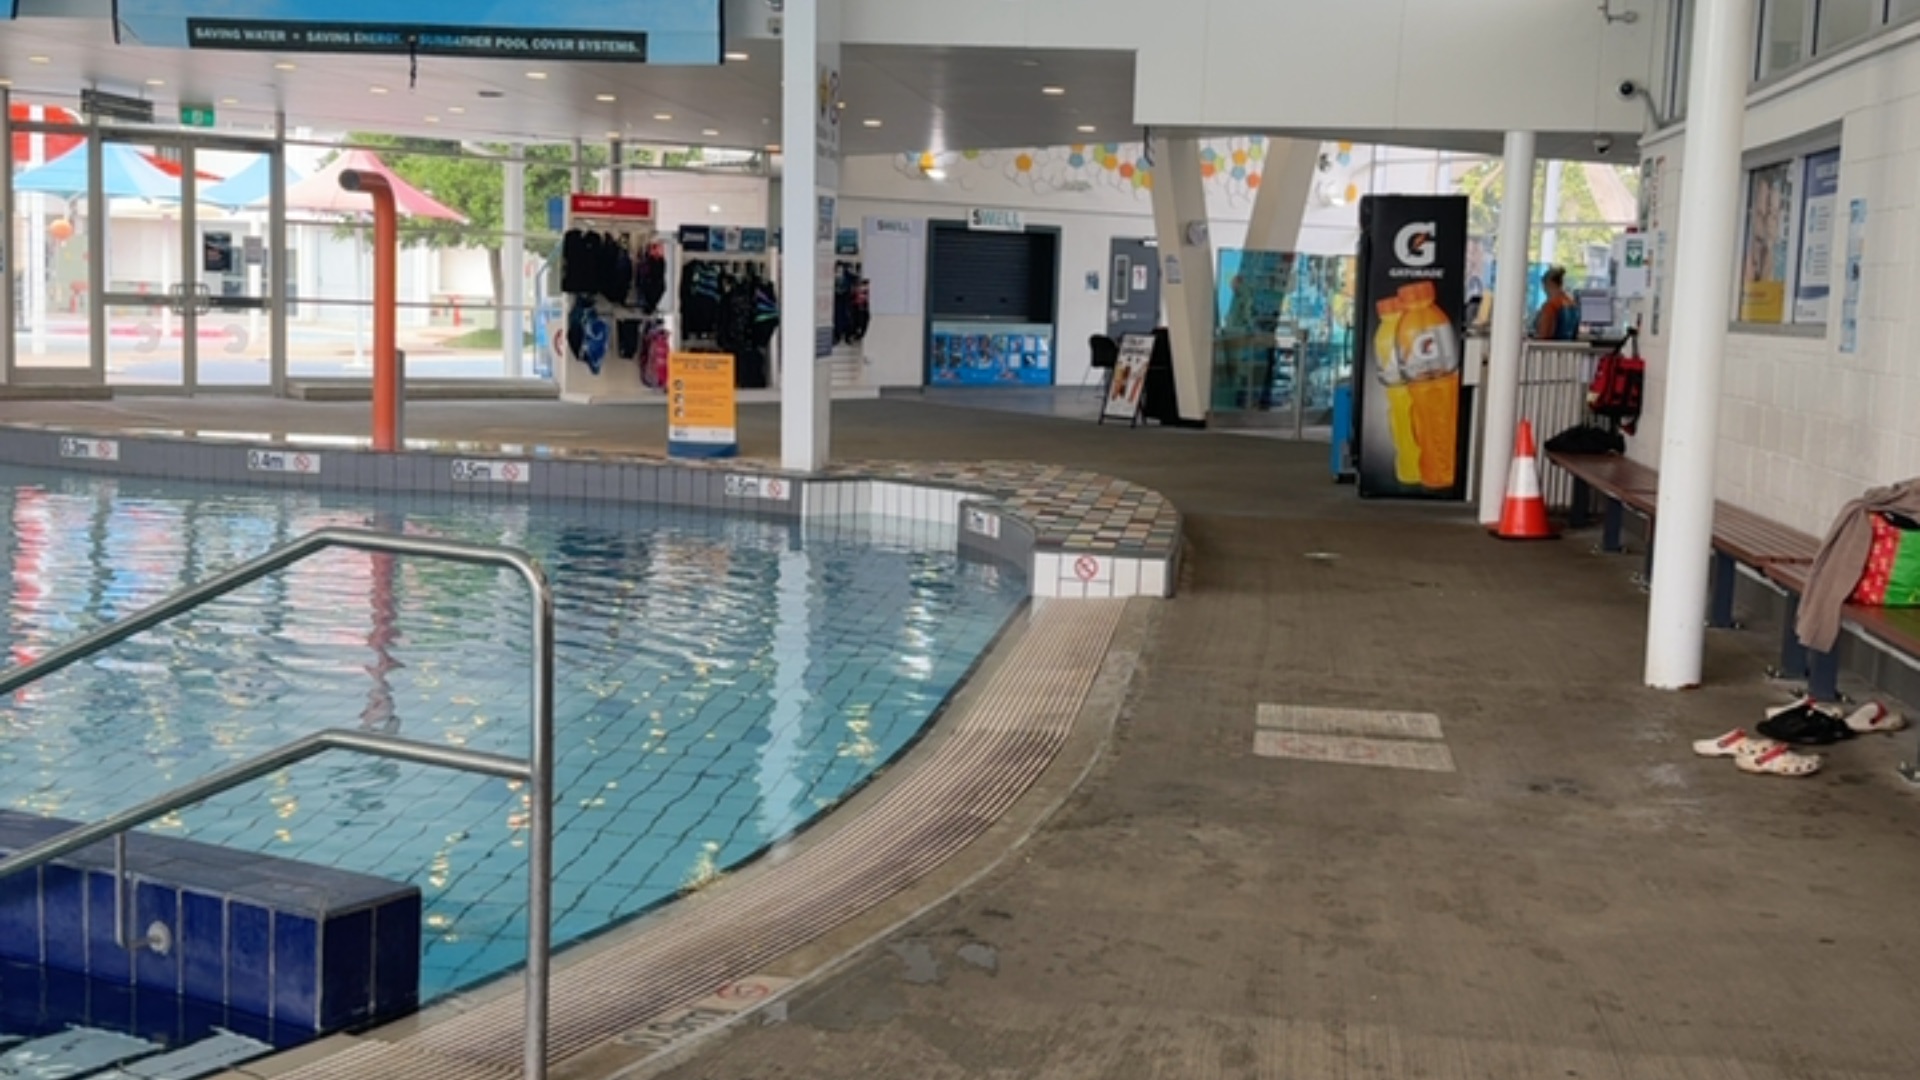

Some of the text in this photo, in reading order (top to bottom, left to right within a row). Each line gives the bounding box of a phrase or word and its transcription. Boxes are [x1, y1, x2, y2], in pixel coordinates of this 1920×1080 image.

[194, 27, 241, 40] SAVING
[244, 29, 286, 42] WATER
[306, 30, 350, 43] SAVING
[495, 36, 529, 49] POOL
[533, 37, 573, 50] COVER
[972, 208, 1020, 227] SWELL
[1394, 221, 1436, 266] G
